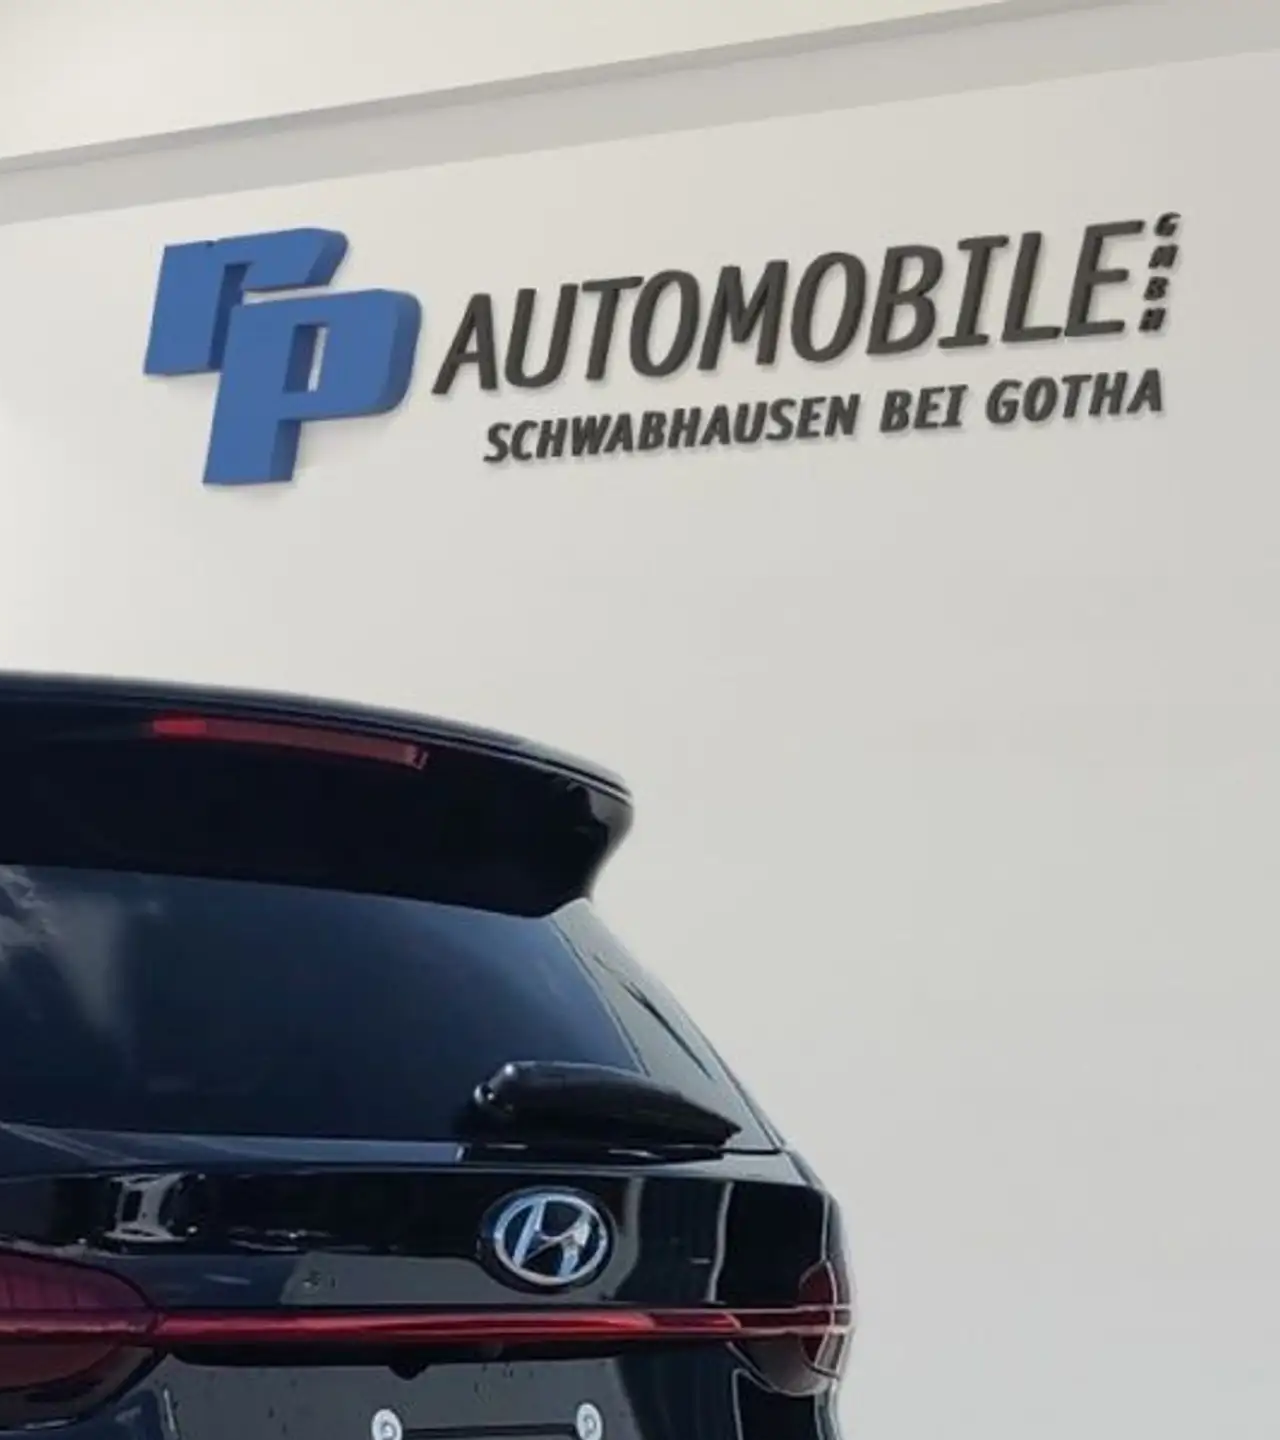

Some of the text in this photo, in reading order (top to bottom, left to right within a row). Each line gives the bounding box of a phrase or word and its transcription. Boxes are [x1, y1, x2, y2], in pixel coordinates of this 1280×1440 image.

[431, 218, 1146, 396] AUTOMOBILE
[483, 368, 1163, 464] SCHWABHAUSEN BEI GOTHA
